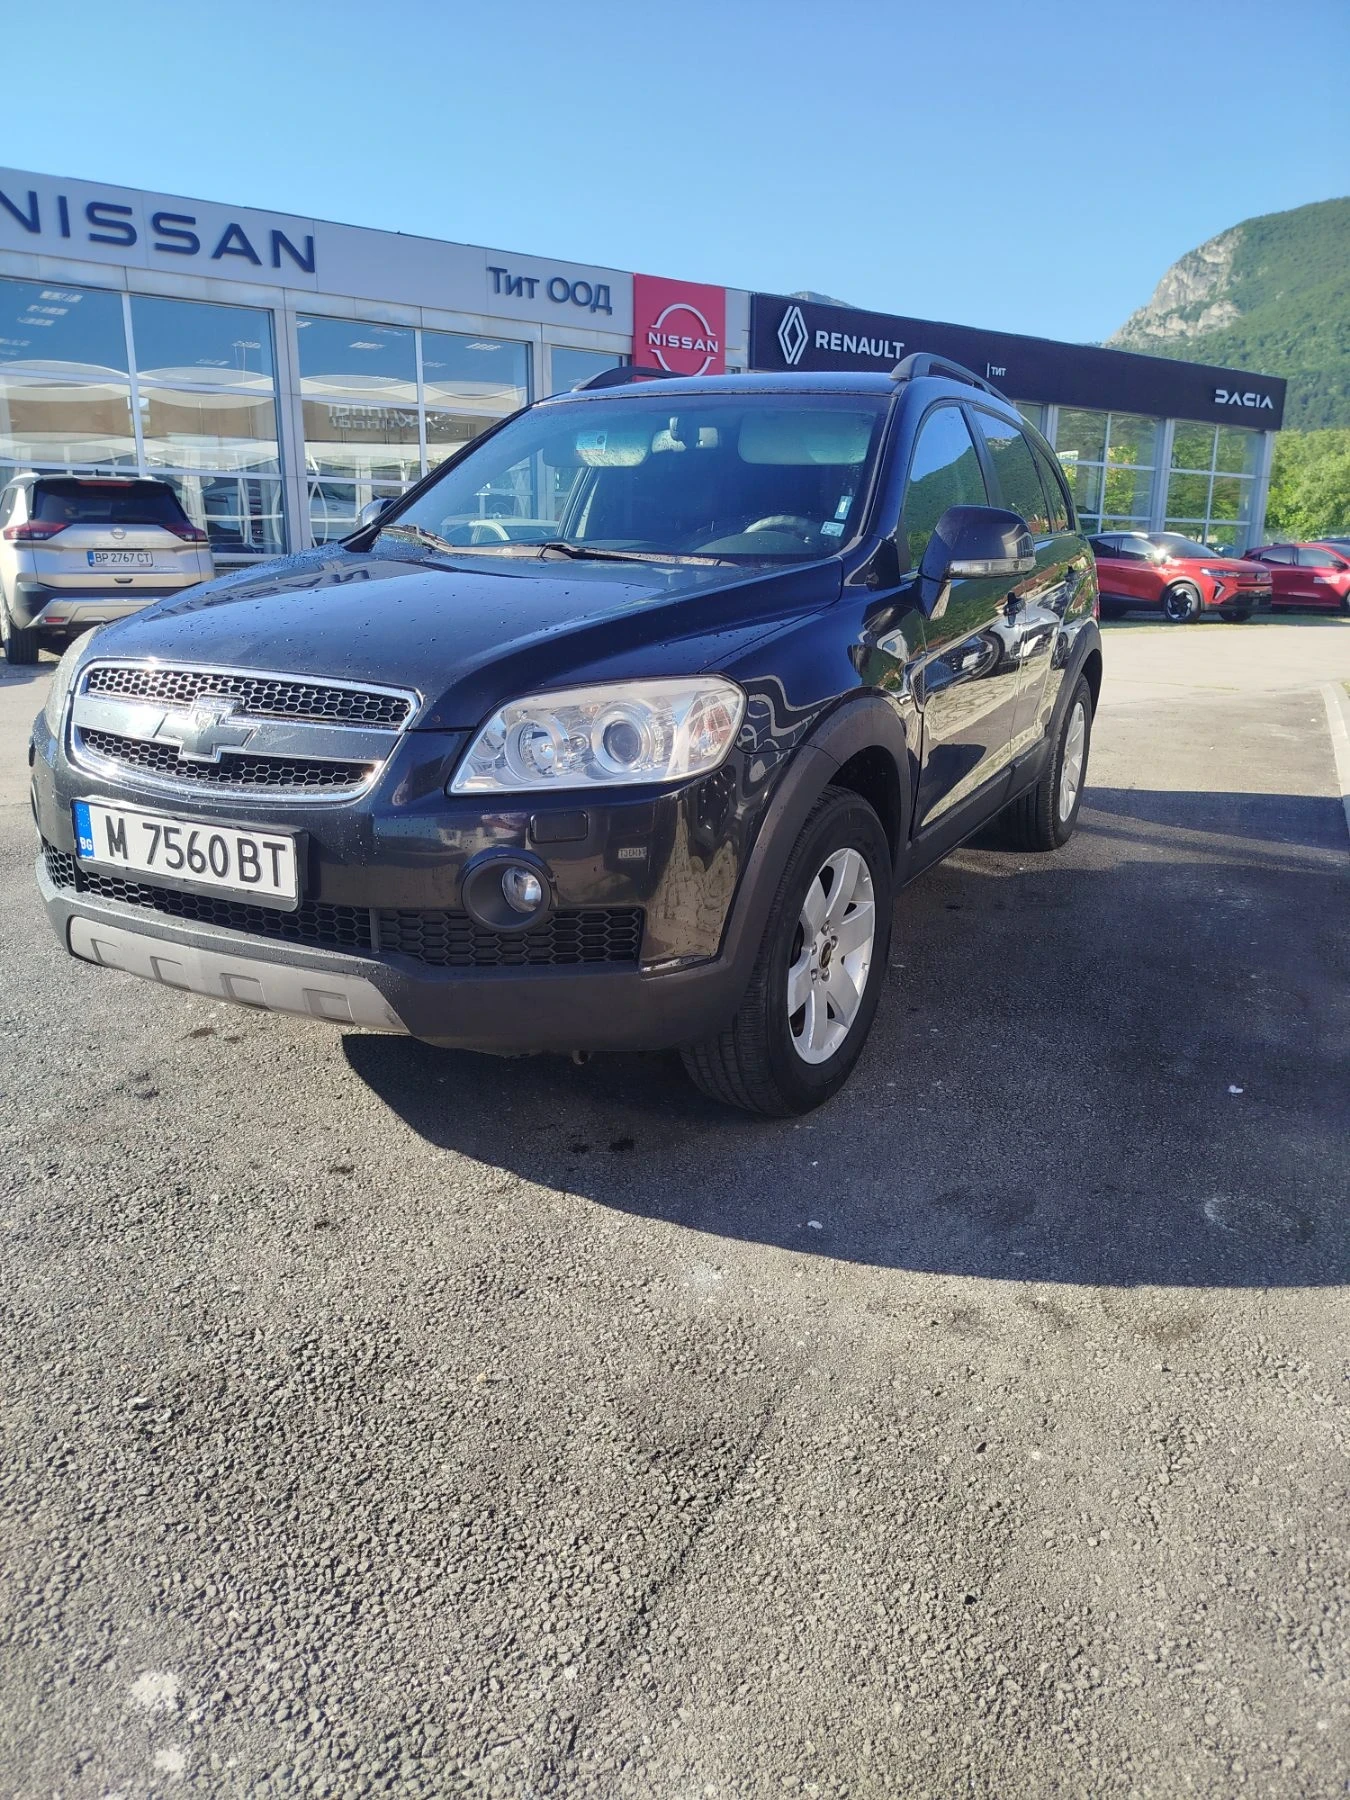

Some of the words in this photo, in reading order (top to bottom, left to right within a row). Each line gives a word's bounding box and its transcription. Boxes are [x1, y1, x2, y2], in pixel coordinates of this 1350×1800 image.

[0, 190, 316, 273] NISSAN
[486, 266, 540, 299] Тит
[547, 276, 613, 316] ООД
[648, 331, 719, 353] NISSAN
[815, 330, 905, 359] RENAULT
[1214, 388, 1274, 410] DACIA
[110, 552, 135, 563] 2767
[79, 836, 93, 851] BG
[105, 815, 129, 860] M
[142, 822, 229, 878] 7560
